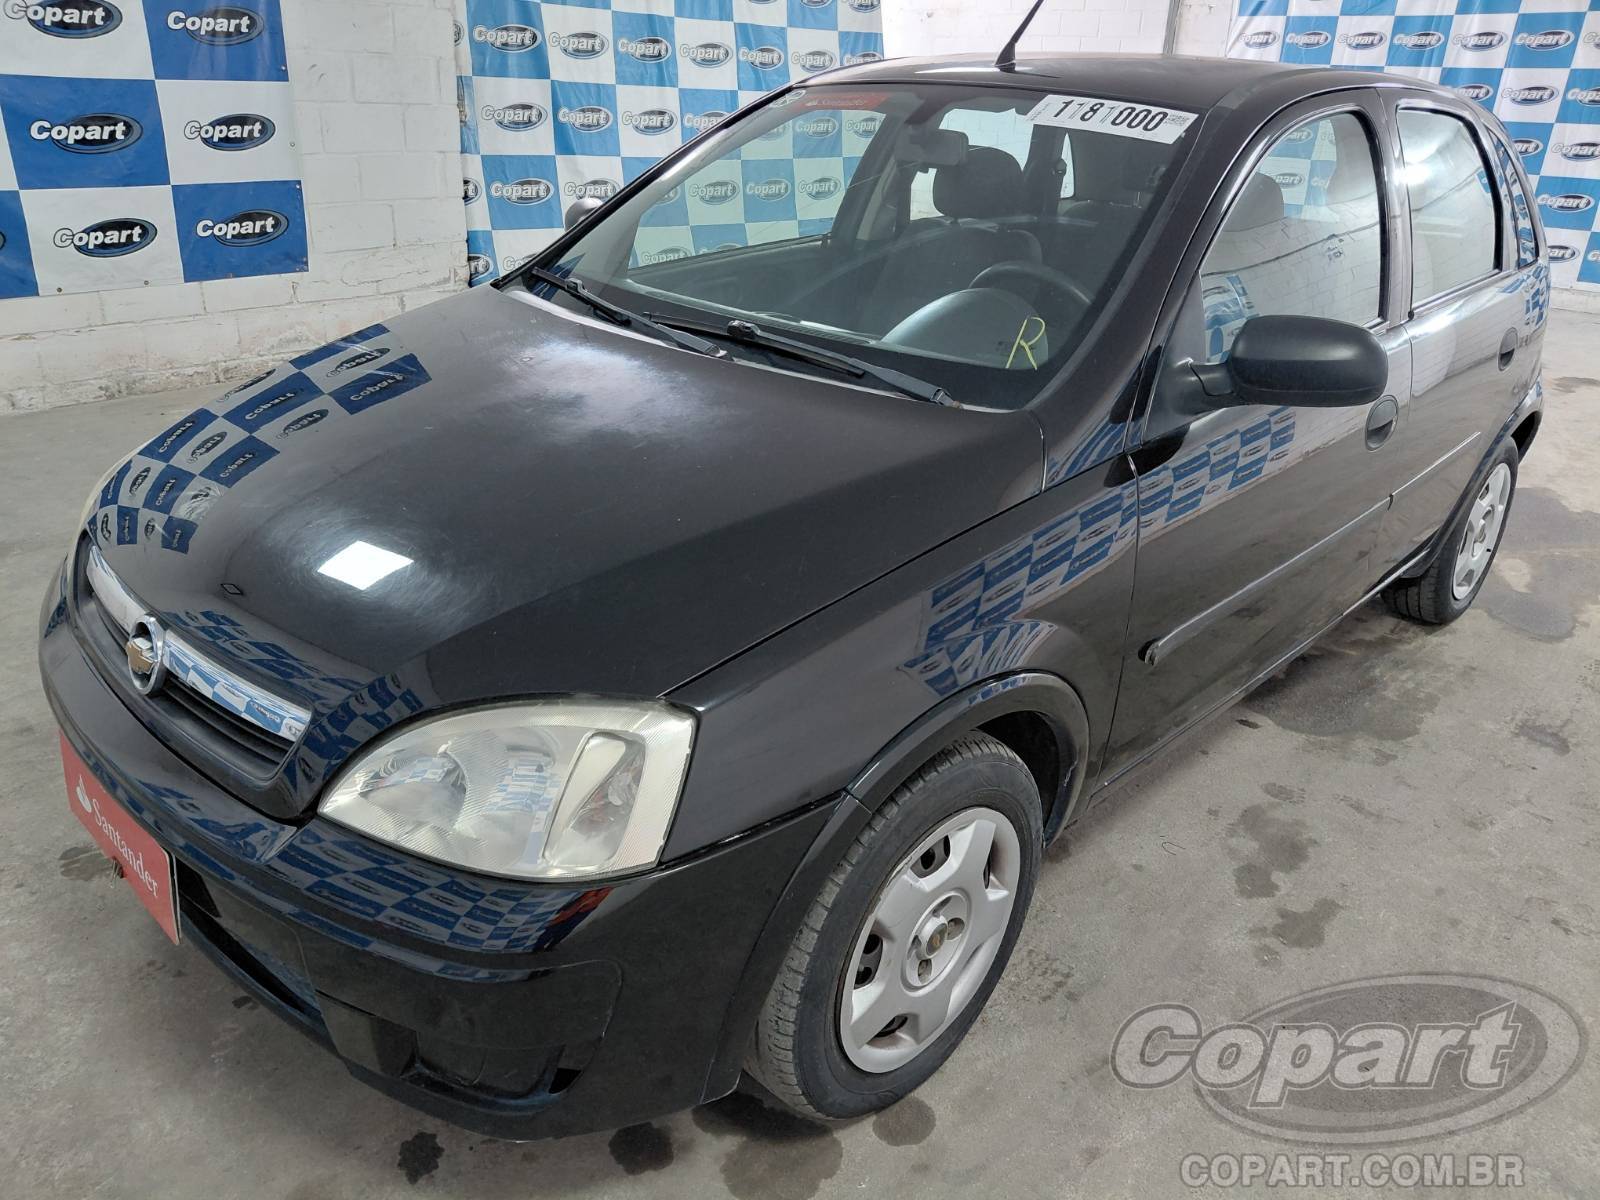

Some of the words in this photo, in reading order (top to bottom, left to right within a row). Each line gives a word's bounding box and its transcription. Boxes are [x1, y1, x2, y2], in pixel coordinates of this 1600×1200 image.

[3, 0, 105, 25] Copart
[167, 11, 250, 34] Copart
[473, 25, 533, 46] Copart
[549, 32, 602, 52] Copart
[1338, 33, 1383, 48] Copart
[1393, 33, 1438, 47] Copart
[1453, 34, 1501, 48] Copart
[1515, 32, 1568, 48] Copart
[618, 38, 667, 56] Copart
[680, 44, 727, 61] Copart
[739, 47, 780, 65] Copart
[791, 51, 831, 67] Copart
[1501, 88, 1552, 103] Copart
[482, 105, 540, 126] Copart
[559, 107, 607, 126] Copart
[622, 111, 670, 129] Copart
[30, 120, 125, 144] Copart
[184, 120, 262, 144] Copart
[490, 181, 548, 200] Copart
[564, 181, 613, 199] Copart
[688, 183, 735, 202] Copart
[746, 182, 787, 199] Copart
[798, 180, 836, 198] Copart
[1538, 193, 1589, 209] Copart
[196, 216, 275, 239] Copart
[54, 225, 142, 250] Copart
[1005, 316, 1046, 370] R
[92, 798, 159, 898] Santander
